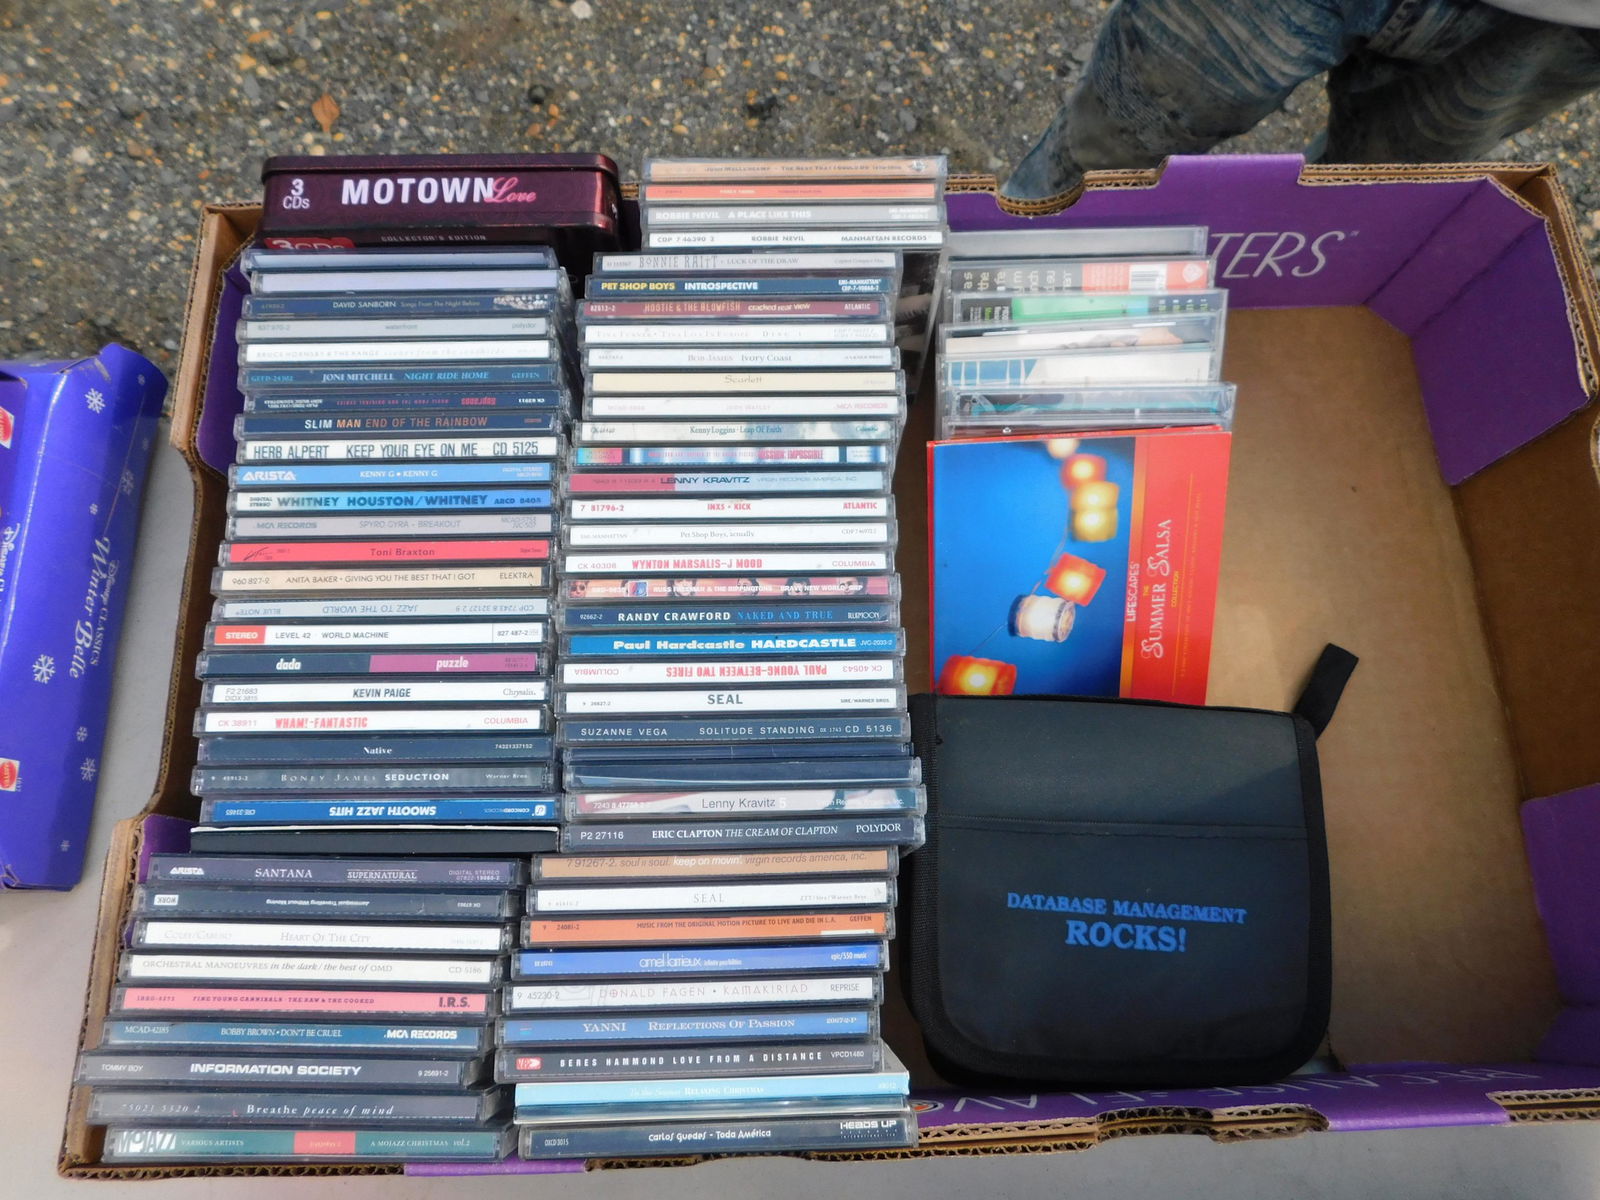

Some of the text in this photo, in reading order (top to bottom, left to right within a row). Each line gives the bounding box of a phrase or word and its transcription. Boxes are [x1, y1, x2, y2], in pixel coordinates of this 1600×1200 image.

[283, 179, 310, 209] 3 CDs
[342, 177, 536, 205] MOTOWN Love
[649, 282, 675, 290] BOYS
[684, 281, 759, 291] INTROSPECTIVE
[321, 373, 344, 383] JONI
[345, 373, 394, 382] MITCHELL
[404, 372, 434, 380] NIGHT
[436, 372, 458, 380] RIDE
[724, 374, 762, 384] Scarlett
[305, 416, 488, 430] SLIM MAN END OF THE RAINBOW
[690, 426, 735, 435] Kenny Loggins
[254, 441, 538, 458] HERB ALPERT KEEP YOUR EYE ON ME CD 5125
[702, 476, 750, 484] KRAVITZ
[371, 548, 435, 556] Toni Braxton
[1127, 563, 1140, 622] LIFESCAPES
[1141, 520, 1172, 659] SUMMER SALSA
[1171, 571, 1179, 607] COLLECTION
[69, 537, 110, 679] Winter Belle
[618, 613, 659, 621] RANDY
[664, 612, 731, 621] CRAWFORD
[737, 612, 774, 620] NAKED
[806, 611, 832, 619] TRUE
[90, 608, 108, 666] CLASSICS
[276, 657, 469, 671] dada puzzle
[707, 694, 743, 705] SEAL
[580, 725, 892, 736] SUZANNE VEGA SOLITUDE STANDING CD 5136
[364, 746, 392, 755] Native
[702, 798, 776, 810] Lenny Kravitz
[329, 806, 437, 817] SMOOTH JAZZ HITS
[581, 832, 592, 840] P2
[652, 830, 674, 838] ERIC
[676, 829, 724, 838] CLAPTON
[725, 828, 744, 838] THE
[745, 828, 778, 837] CREAM
[780, 827, 793, 836] OF
[795, 826, 838, 835] CLAPTON
[856, 824, 901, 833] POLYDOR
[694, 893, 725, 903] SEAL
[1008, 892, 1247, 924] DATABASE MANAGEMENT
[687, 920, 716, 928] ORIGINAL
[1066, 920, 1187, 952] ROCKS!
[143, 961, 202, 969] ORCHESTRAL
[206, 962, 267, 970] MANOEUVRES
[281, 962, 295, 970] the
[297, 962, 318, 971] dark
[360, 964, 368, 972] of
[527, 983, 859, 999] 45230-2 DONALD FAGEN KAMAKIRIAD REPRISE
[583, 1019, 795, 1032] YANNI REFLECTIONS OF PASSION
[280, 1028, 305, 1037] DON'T
[306, 1029, 316, 1037] BE
[387, 1030, 408, 1038] MCA
[411, 1031, 457, 1039] RECORDS
[560, 1057, 597, 1067] BERES
[606, 1056, 664, 1066] HAMMOND
[672, 1056, 700, 1065] LOVE
[710, 1054, 740, 1063] FROM
[749, 1054, 754, 1062] A
[763, 1052, 822, 1062] DISTANCE
[190, 1064, 292, 1074] INFORMATION
[297, 1066, 361, 1075] SOCIETY
[247, 1104, 393, 1117] Breathe peace of mind
